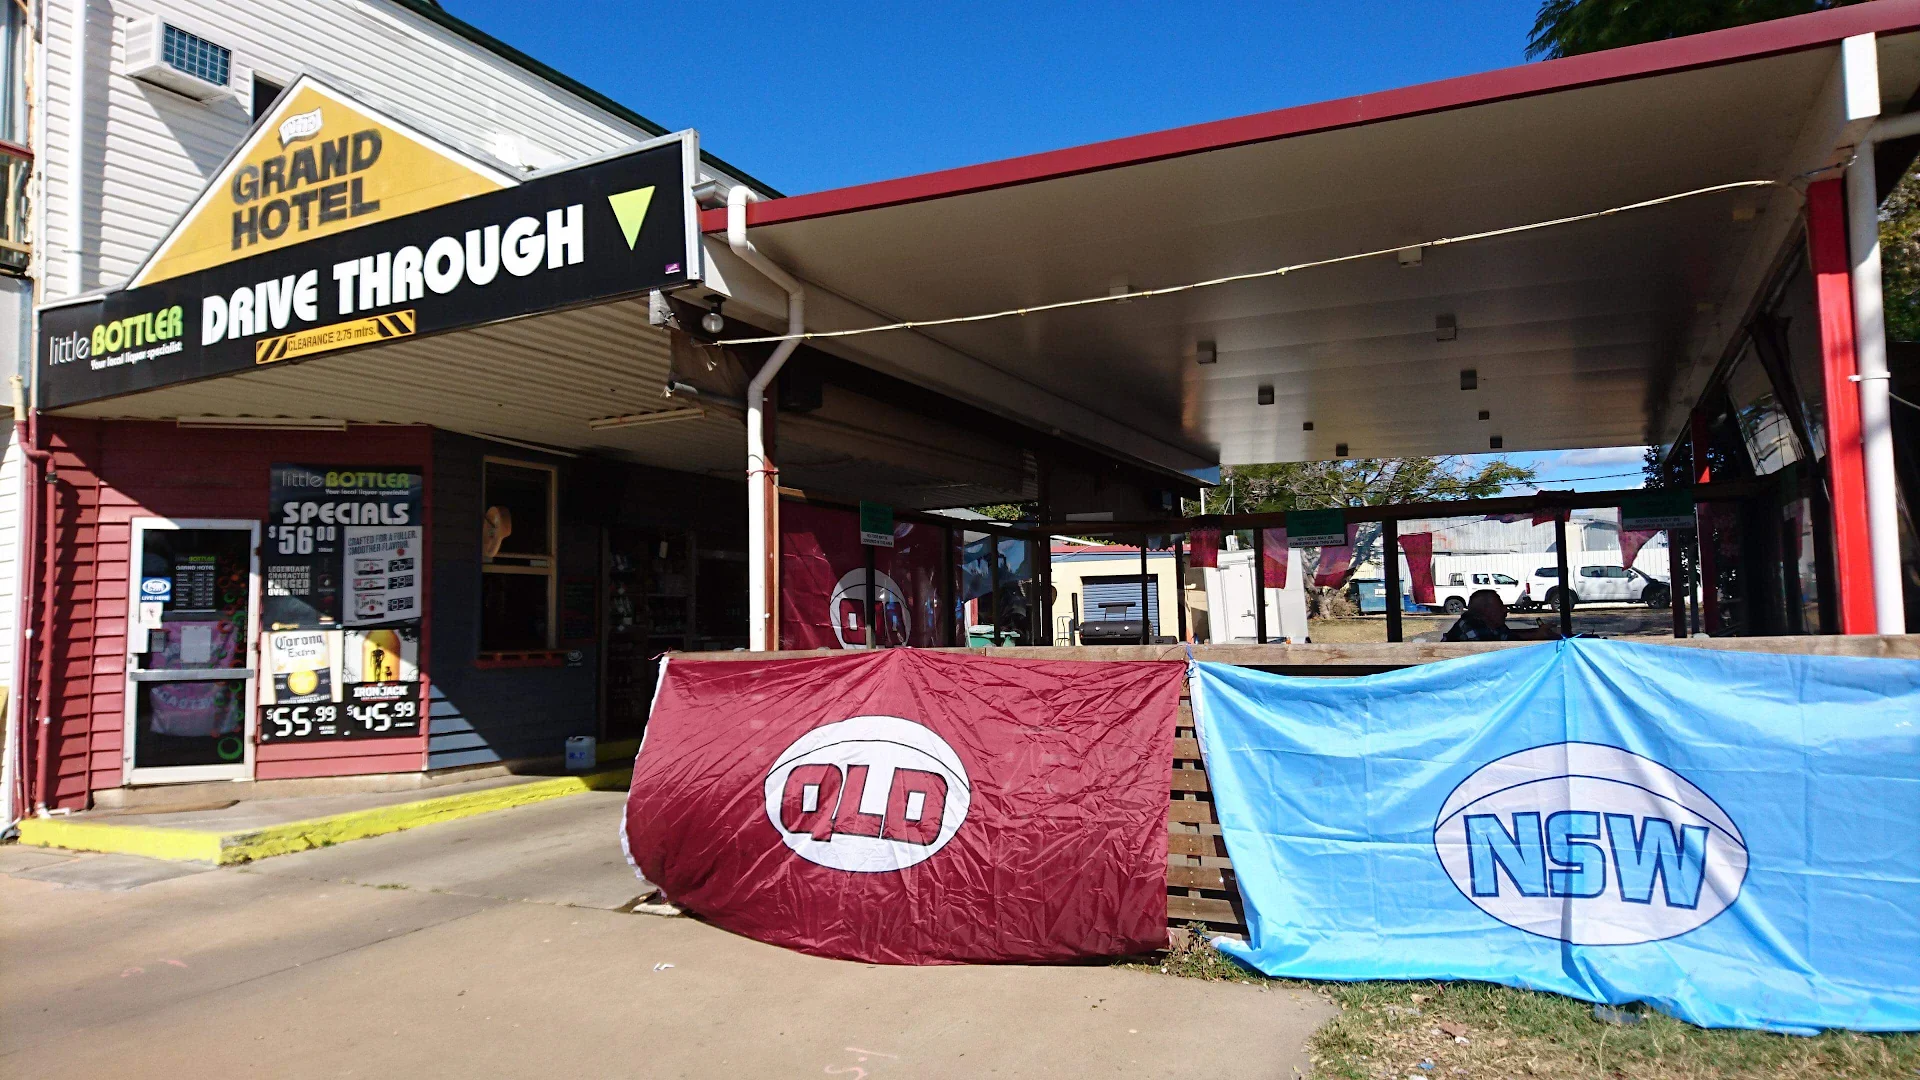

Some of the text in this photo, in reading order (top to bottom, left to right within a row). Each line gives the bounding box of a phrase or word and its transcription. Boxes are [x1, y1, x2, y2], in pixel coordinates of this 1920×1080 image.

[231, 128, 383, 205] GRAND
[231, 177, 381, 251] HOTEL
[201, 203, 584, 346] DRIVE THROUGH
[50, 305, 183, 366] little BOTTLER
[288, 326, 376, 352] CLEARANCE 2.75 mtrs.
[91, 341, 183, 370] Your local liquor specialist
[282, 470, 410, 488] little BOTTLER
[358, 489, 378, 497] liquor
[282, 501, 409, 525] SPECIALS
[347, 535, 375, 547] CRAFTED
[375, 533, 388, 543] FOR
[388, 533, 393, 541] A
[347, 543, 381, 556] SMOOTHER
[268, 565, 311, 573] LEGENDARY
[267, 588, 291, 596] OVER
[291, 588, 309, 596] TIME
[268, 579, 309, 589] FORGED
[275, 634, 325, 650] Corona
[287, 648, 316, 658] Extra
[353, 686, 379, 698] IRON
[380, 685, 408, 697] JACK
[780, 762, 949, 846] QLD
[1464, 810, 1710, 910] NSW
